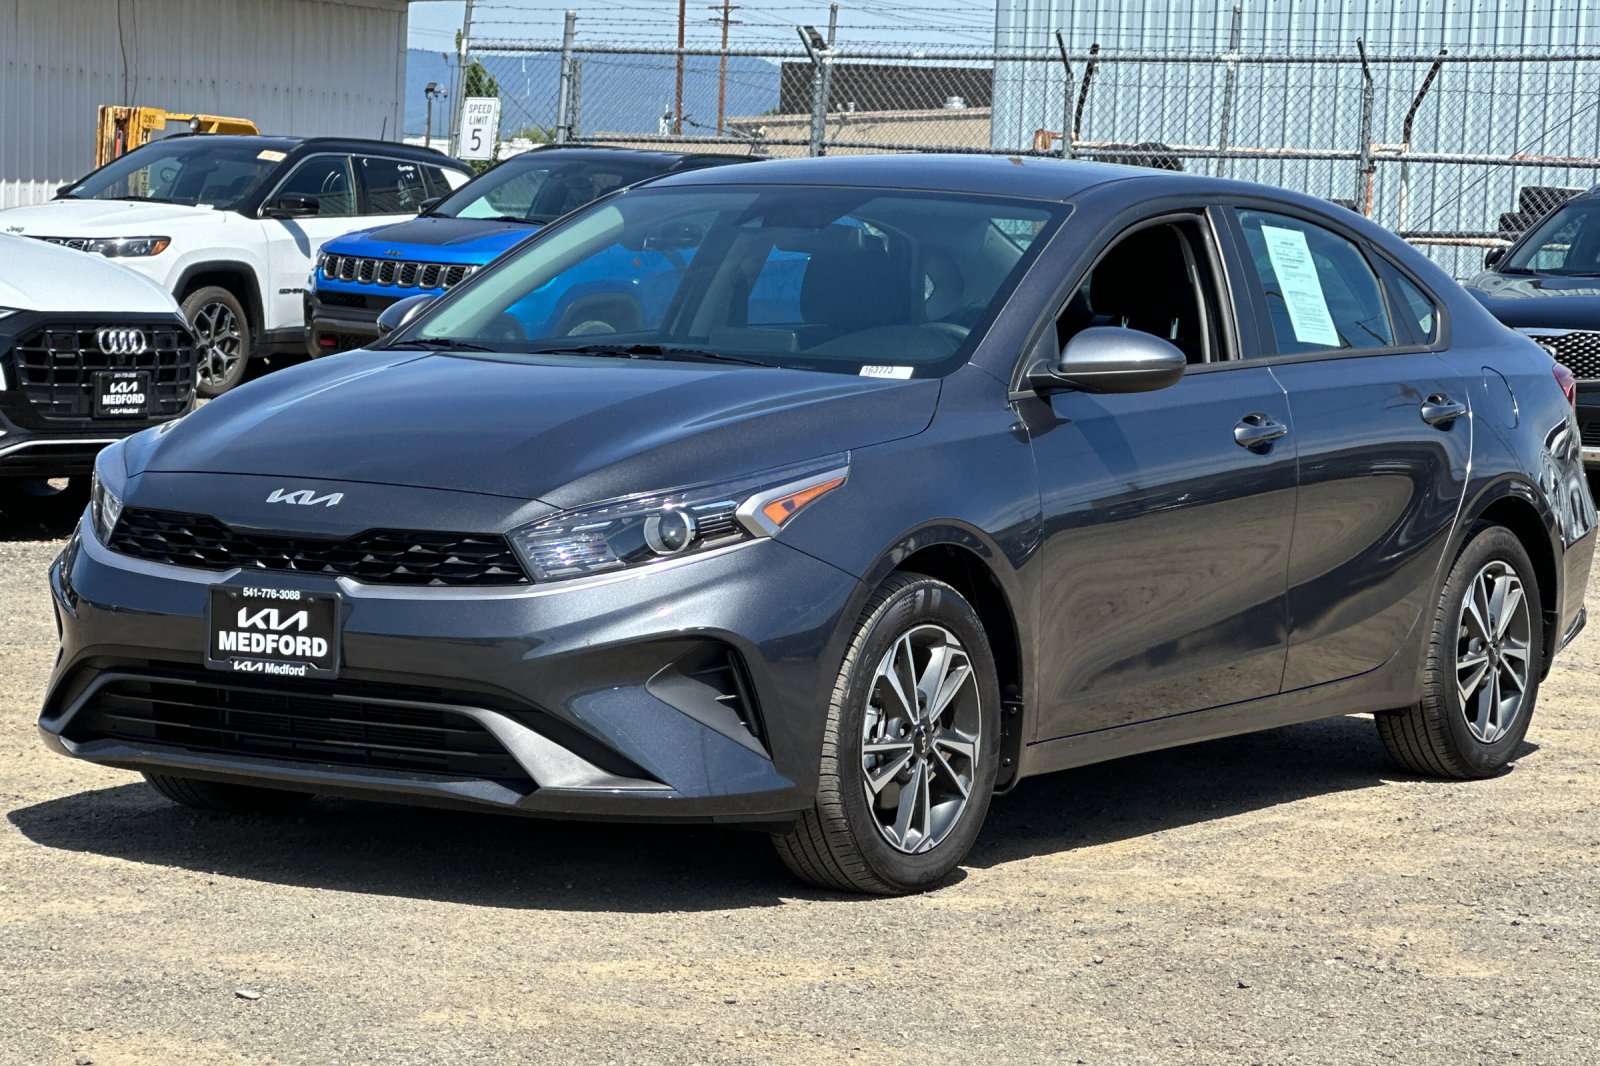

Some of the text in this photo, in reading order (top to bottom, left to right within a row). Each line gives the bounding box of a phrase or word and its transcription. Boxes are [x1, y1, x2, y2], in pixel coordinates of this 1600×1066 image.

[468, 104, 492, 114] SPEED
[468, 116, 488, 125] LIMIT
[470, 129, 481, 151] 5
[102, 393, 145, 405] MEDFORD
[266, 488, 344, 507] KIA
[237, 607, 308, 632] KIA
[219, 630, 327, 657] MEDFORD
[265, 662, 305, 676] Medford
